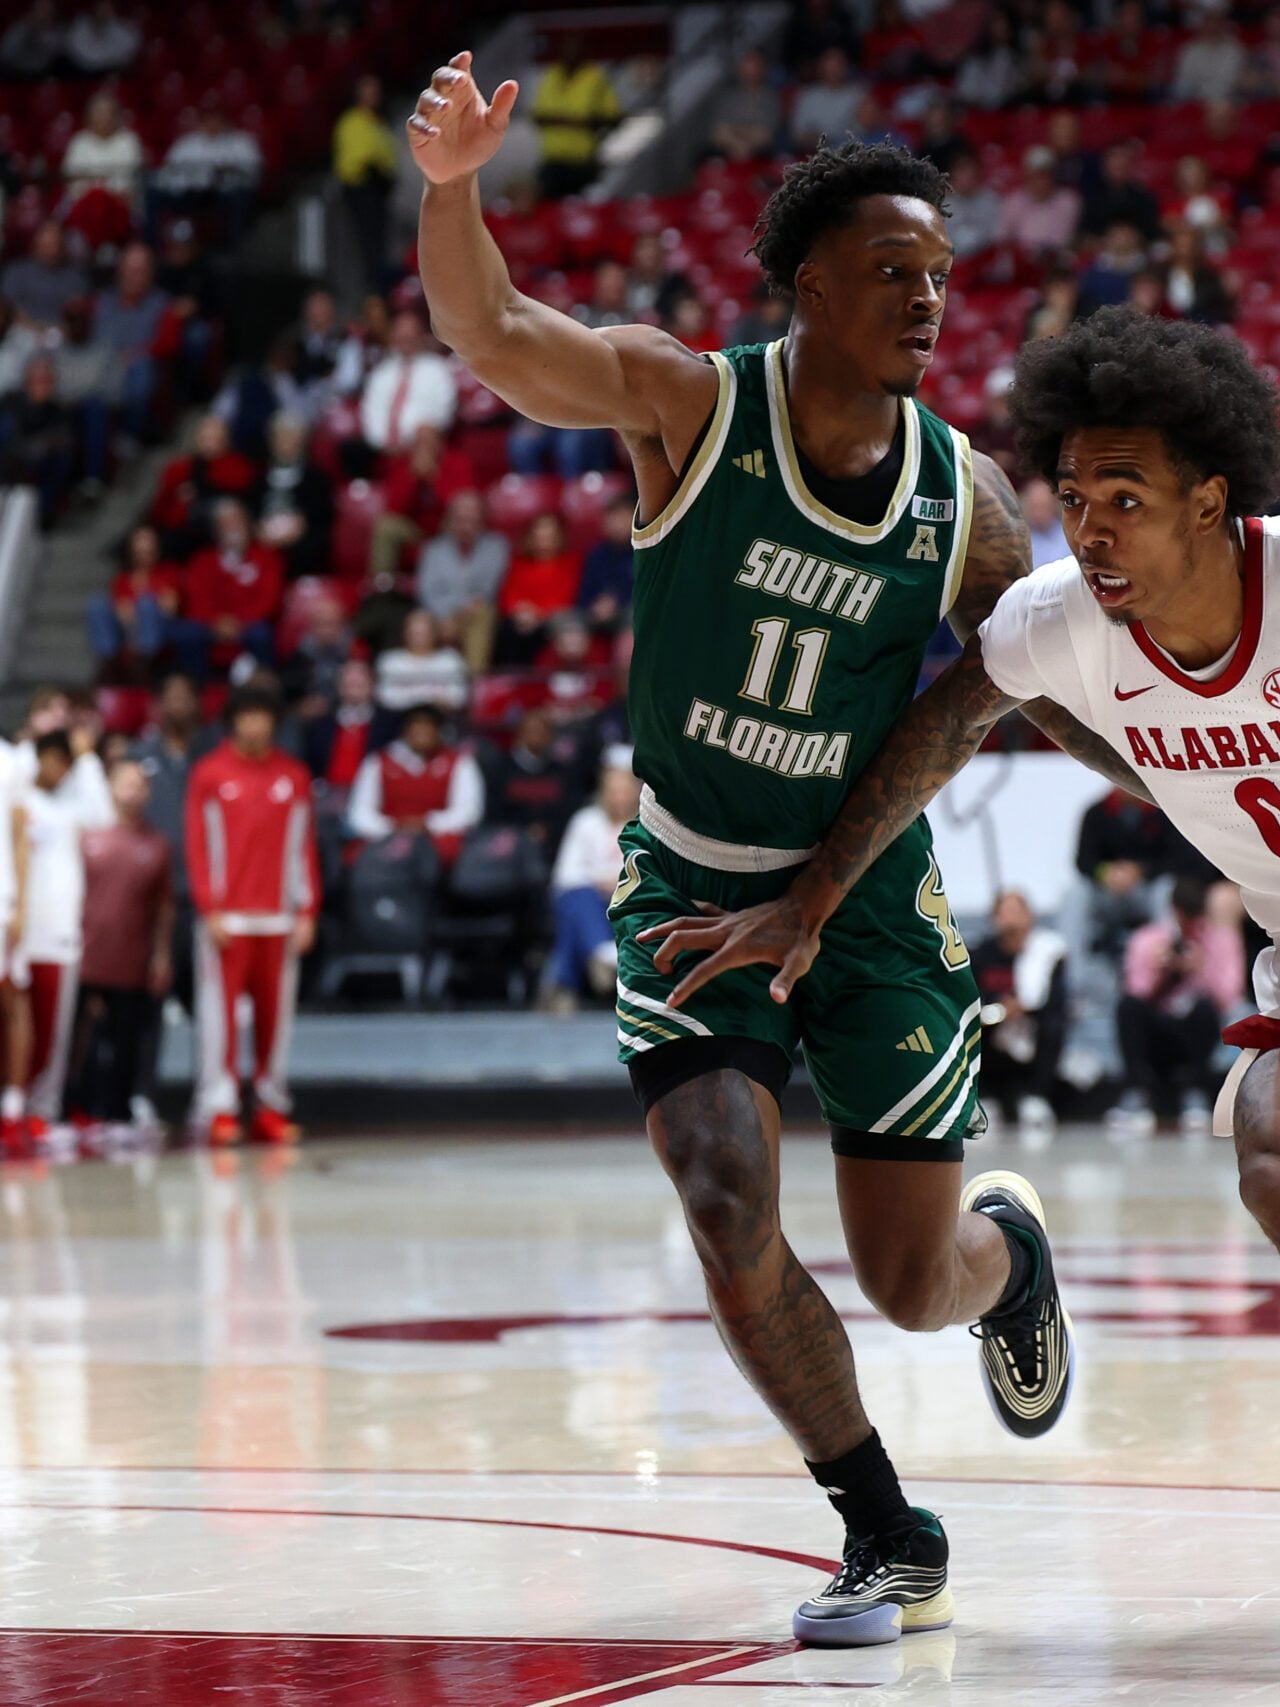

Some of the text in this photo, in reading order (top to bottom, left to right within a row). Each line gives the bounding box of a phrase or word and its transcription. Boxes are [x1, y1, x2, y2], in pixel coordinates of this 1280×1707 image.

[919, 500, 946, 519] AAR
[734, 538, 887, 625] SOUTH
[738, 616, 831, 716] 11
[684, 697, 851, 778] FLORIDA
